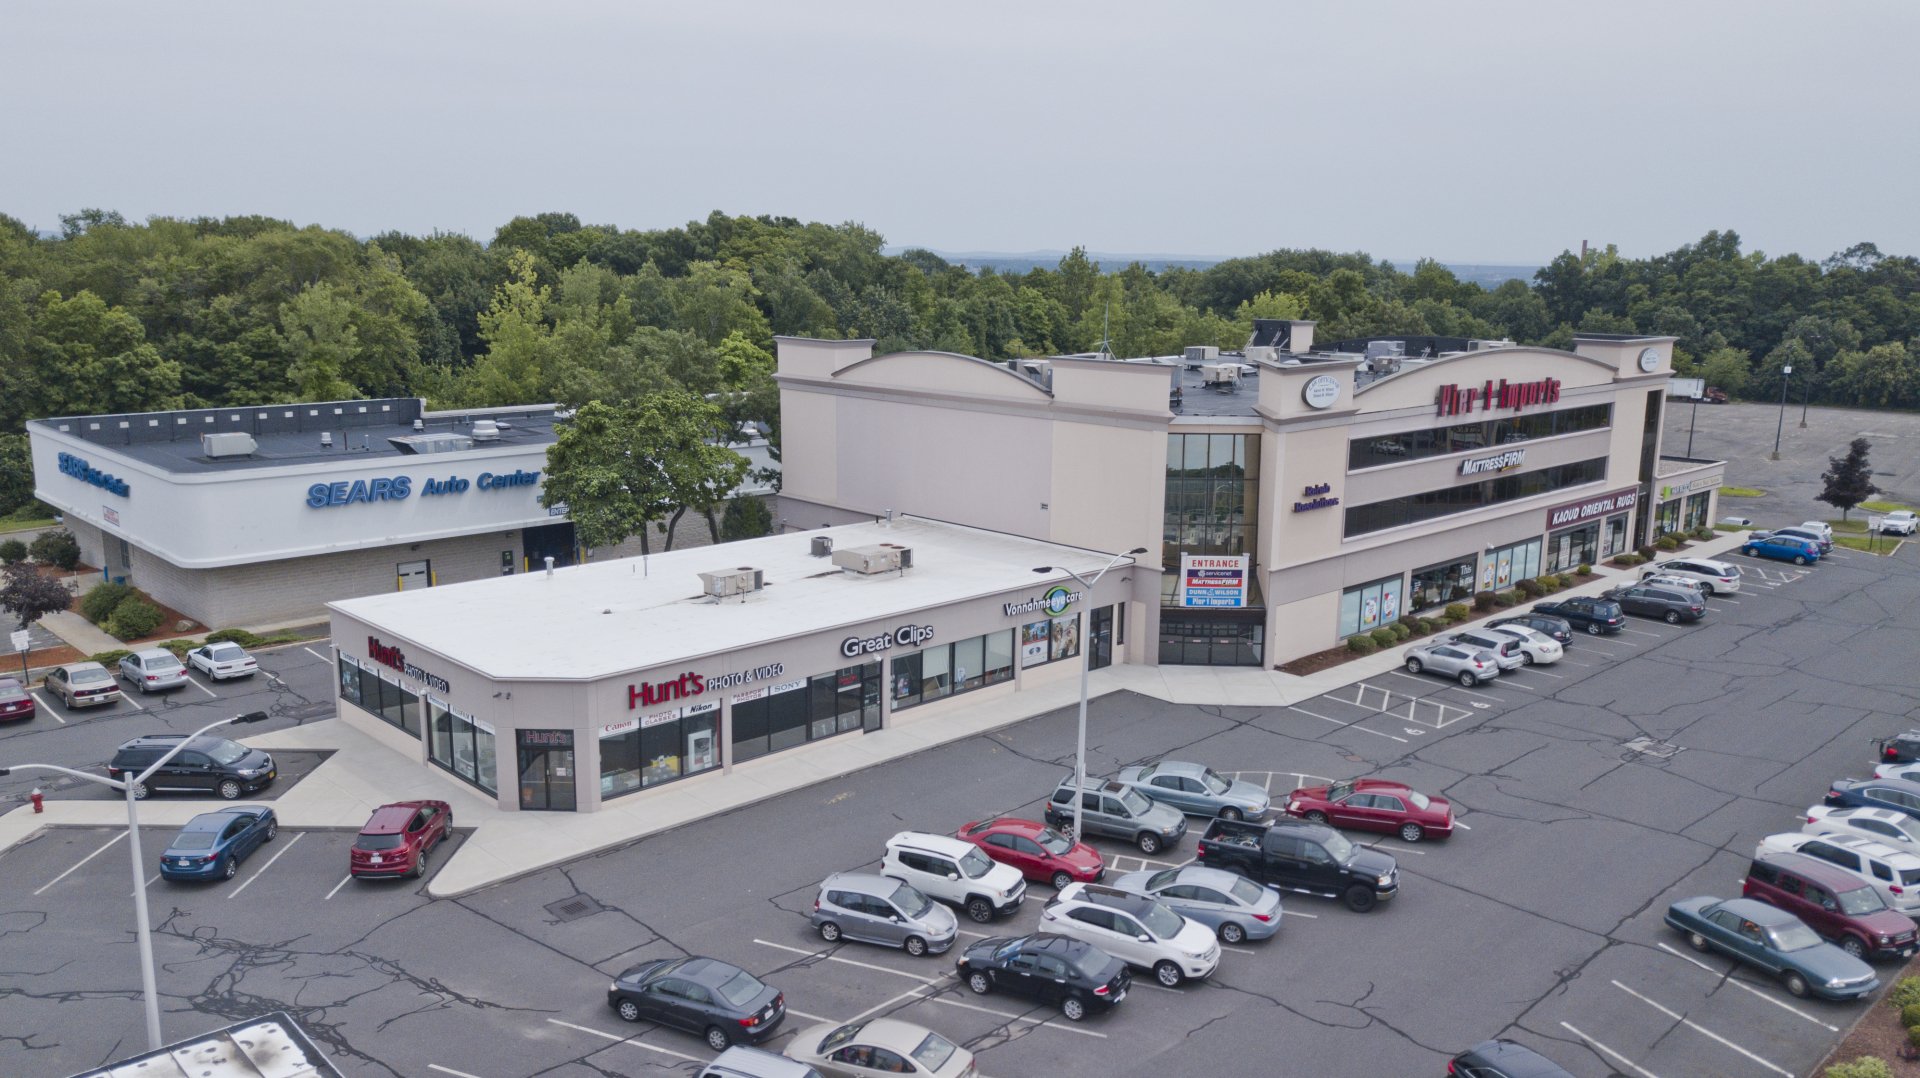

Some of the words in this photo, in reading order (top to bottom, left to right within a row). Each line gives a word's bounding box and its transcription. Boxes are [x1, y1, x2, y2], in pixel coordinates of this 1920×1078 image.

[1497, 377, 1561, 412] Imports
[58, 452, 89, 481] SEARS
[307, 476, 412, 509] SEARS
[421, 475, 470, 497] Auto
[476, 469, 541, 490] Center
[1552, 507, 1579, 525] KAOUD
[1580, 498, 1614, 519] ORIENTAL
[1616, 493, 1636, 509] RUGS
[1210, 598, 1235, 606] Imports
[841, 632, 892, 657] Great
[894, 624, 934, 646] Clips
[628, 672, 706, 710] Hunt's
[706, 673, 743, 692] PHOTO
[744, 671, 753, 683] &
[755, 663, 785, 680] VIDEO
[774, 681, 801, 692] SONY
[648, 710, 673, 719] PHOTO
[689, 703, 713, 713] Nikon
[604, 721, 632, 732] Canon
[526, 731, 567, 744] Hunt's
